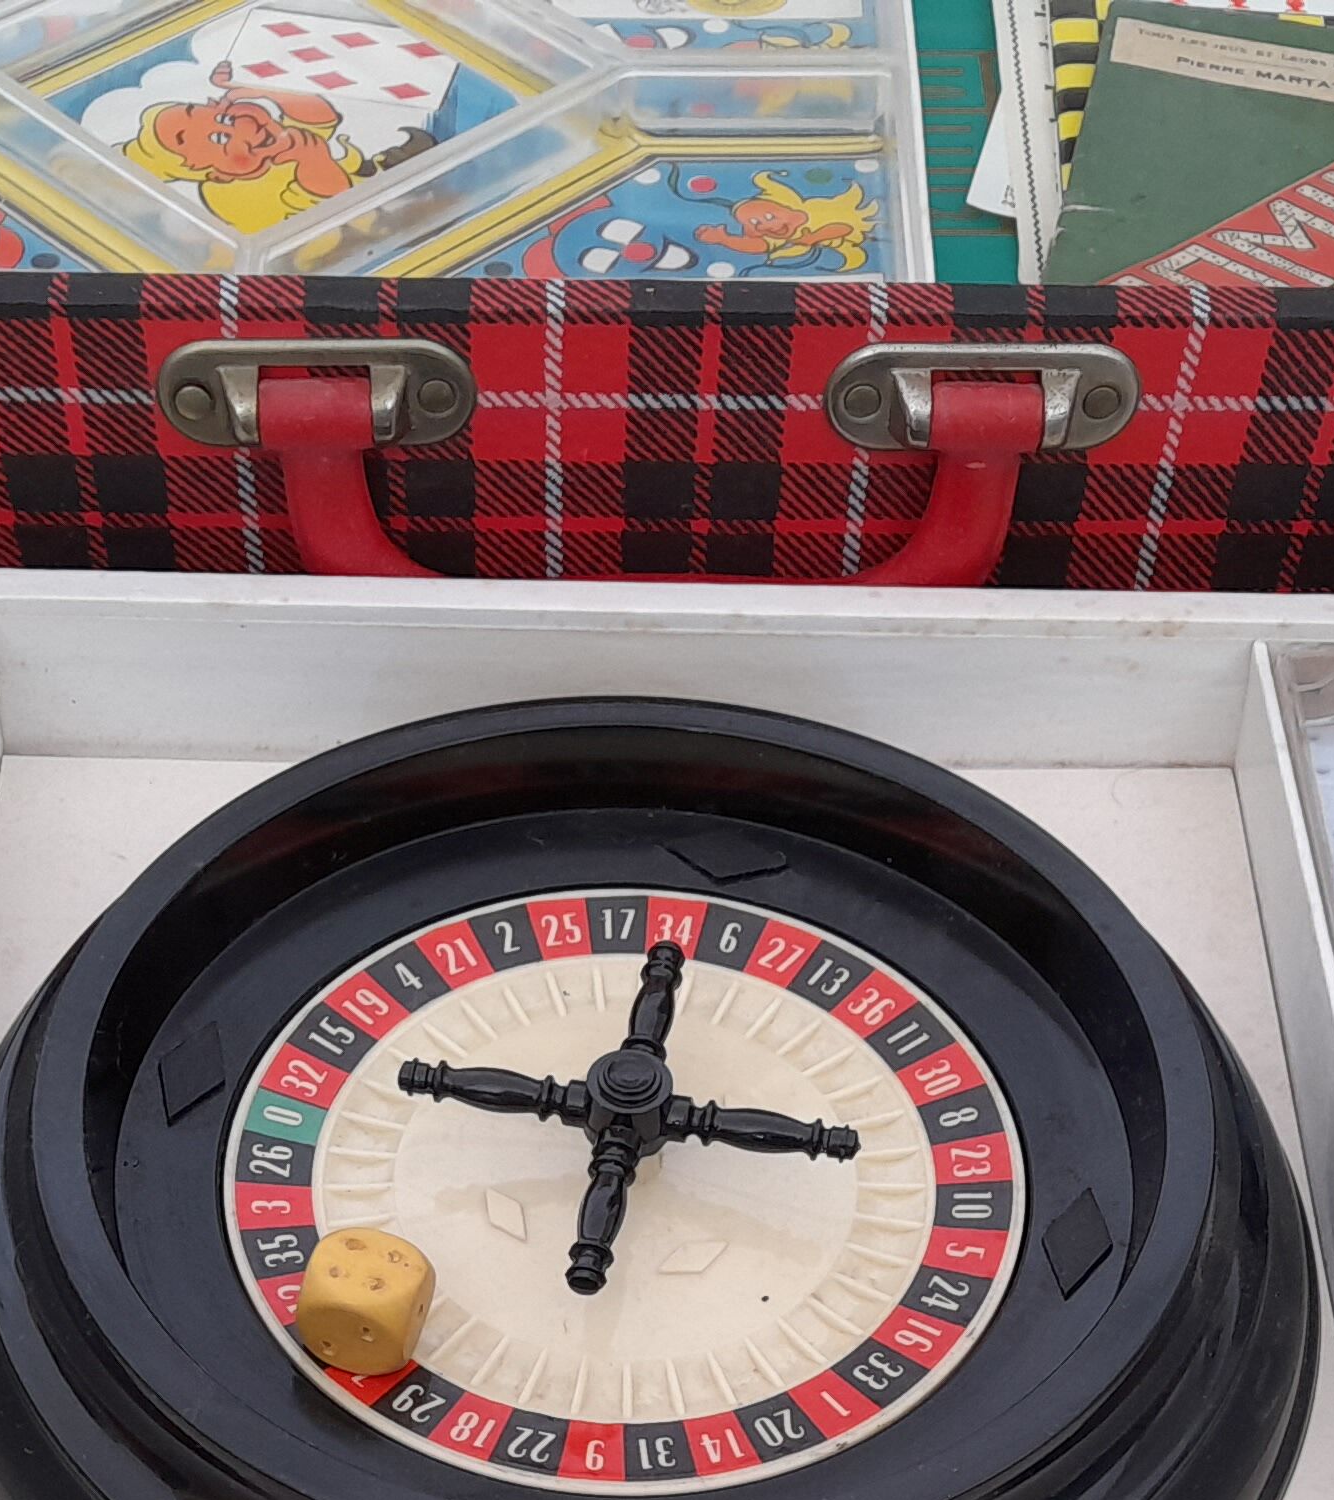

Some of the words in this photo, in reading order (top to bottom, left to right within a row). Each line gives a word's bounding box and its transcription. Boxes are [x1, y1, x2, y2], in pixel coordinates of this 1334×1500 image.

[1176, 55, 1245, 76] PIERRE
[493, 920, 521, 954] 2
[540, 912, 582, 948] 25
[600, 908, 637, 941] 17
[653, 913, 694, 946] 34
[718, 921, 743, 954] 6
[436, 937, 478, 976] 21
[757, 937, 805, 974] 27
[394, 962, 423, 991] 4
[807, 957, 851, 996] 13
[341, 987, 391, 1026] 19
[847, 987, 896, 1027] 36
[307, 1016, 356, 1056] 15
[886, 1020, 931, 1057] 11
[279, 1058, 329, 1098] 32
[914, 1058, 963, 1097] 30
[262, 1105, 304, 1127] 0
[938, 1105, 979, 1128] 8
[248, 1143, 293, 1179] 26
[949, 1143, 991, 1178] 23
[250, 1198, 292, 1215] 3
[951, 1190, 993, 1220] 10
[256, 1233, 305, 1268] 35
[945, 1241, 986, 1261] 5
[920, 1275, 970, 1311] 24
[893, 1315, 943, 1354] 16
[852, 1350, 905, 1391] 33
[391, 1384, 448, 1423] 29
[819, 1390, 852, 1418] 1
[448, 1410, 500, 1449] 18
[506, 1425, 557, 1464] 22
[698, 1427, 745, 1464] 14
[753, 1408, 806, 1448] 20
[584, 1438, 605, 1472] 9
[637, 1436, 678, 1470] 31
